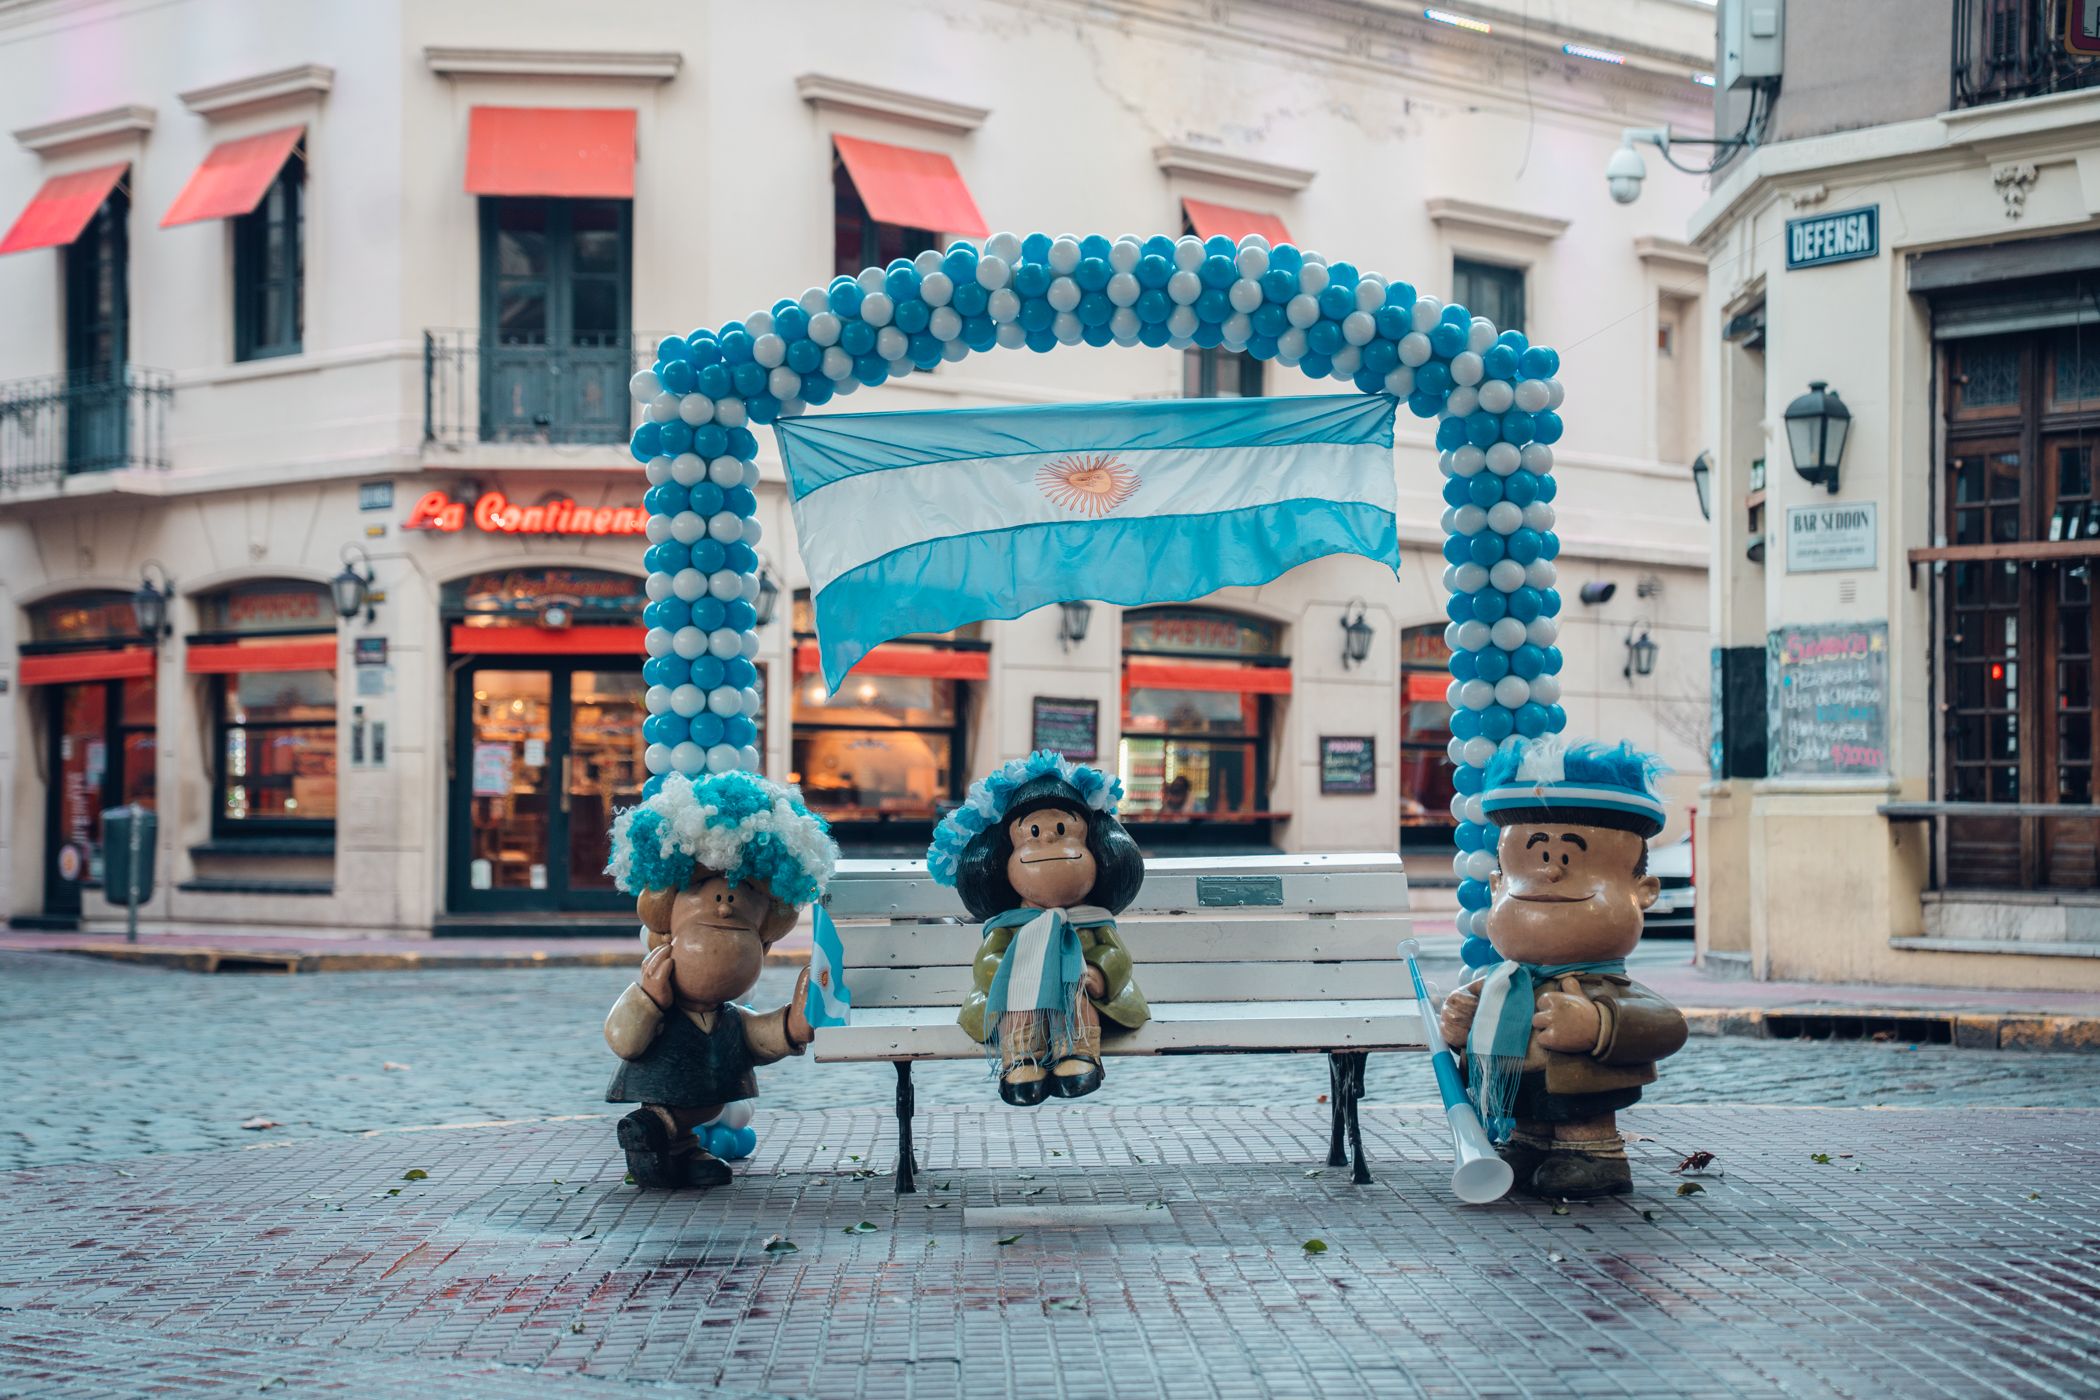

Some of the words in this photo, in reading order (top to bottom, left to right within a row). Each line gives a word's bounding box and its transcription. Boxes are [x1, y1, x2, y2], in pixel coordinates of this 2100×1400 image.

[1792, 214, 1870, 262] DEFENSA
[1793, 514, 1817, 533] BAR
[1821, 510, 1869, 531] SEDDON
